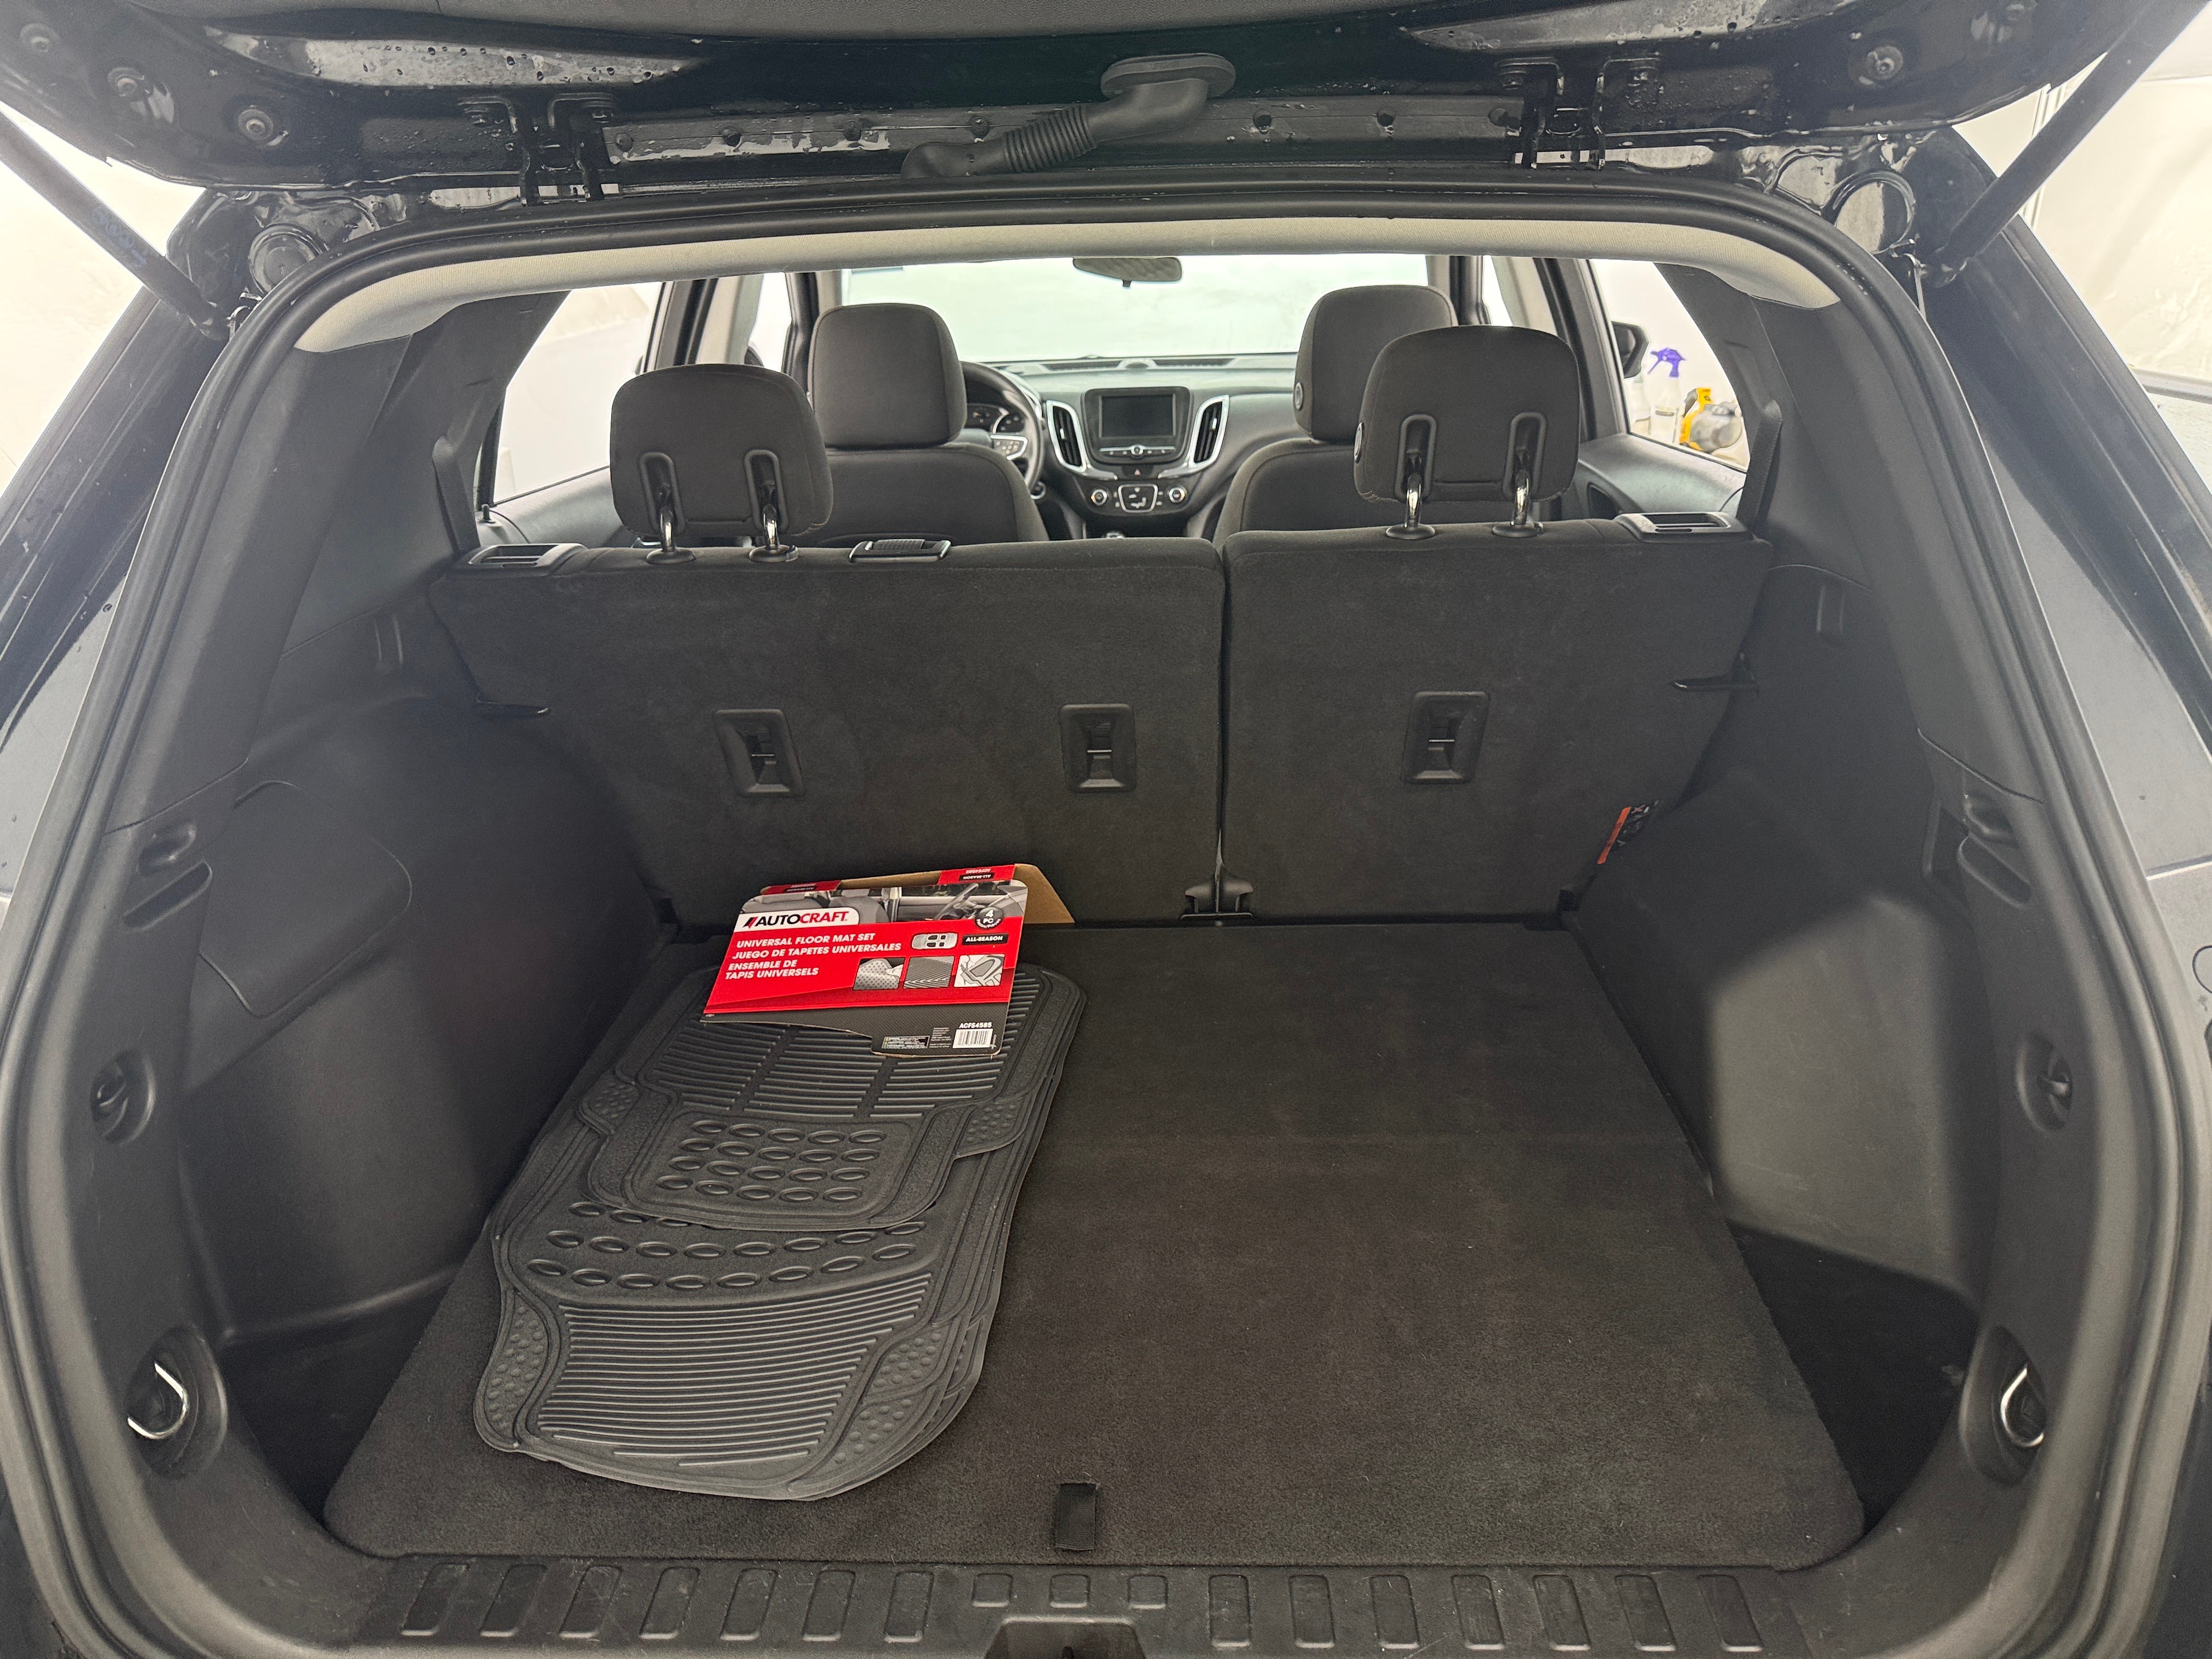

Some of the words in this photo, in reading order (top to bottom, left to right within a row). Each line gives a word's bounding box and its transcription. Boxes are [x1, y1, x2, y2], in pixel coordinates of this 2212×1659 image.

[754, 911, 849, 927] AUTOCRAFT
[985, 910, 994, 918] 4
[736, 937, 792, 948] UNIVERSAL
[795, 934, 830, 945] FLOOR
[832, 934, 855, 943] MAT
[856, 933, 876, 941] SET
[732, 949, 769, 960] JUEGO
[771, 949, 785, 957] DE
[788, 946, 830, 956] TAPETES
[832, 943, 902, 954] UNIVERSALES
[728, 961, 781, 970] ENSEMBLE
[783, 959, 798, 968] DE
[725, 970, 754, 980] TAPIS
[757, 967, 819, 978] UNIVERSELS
